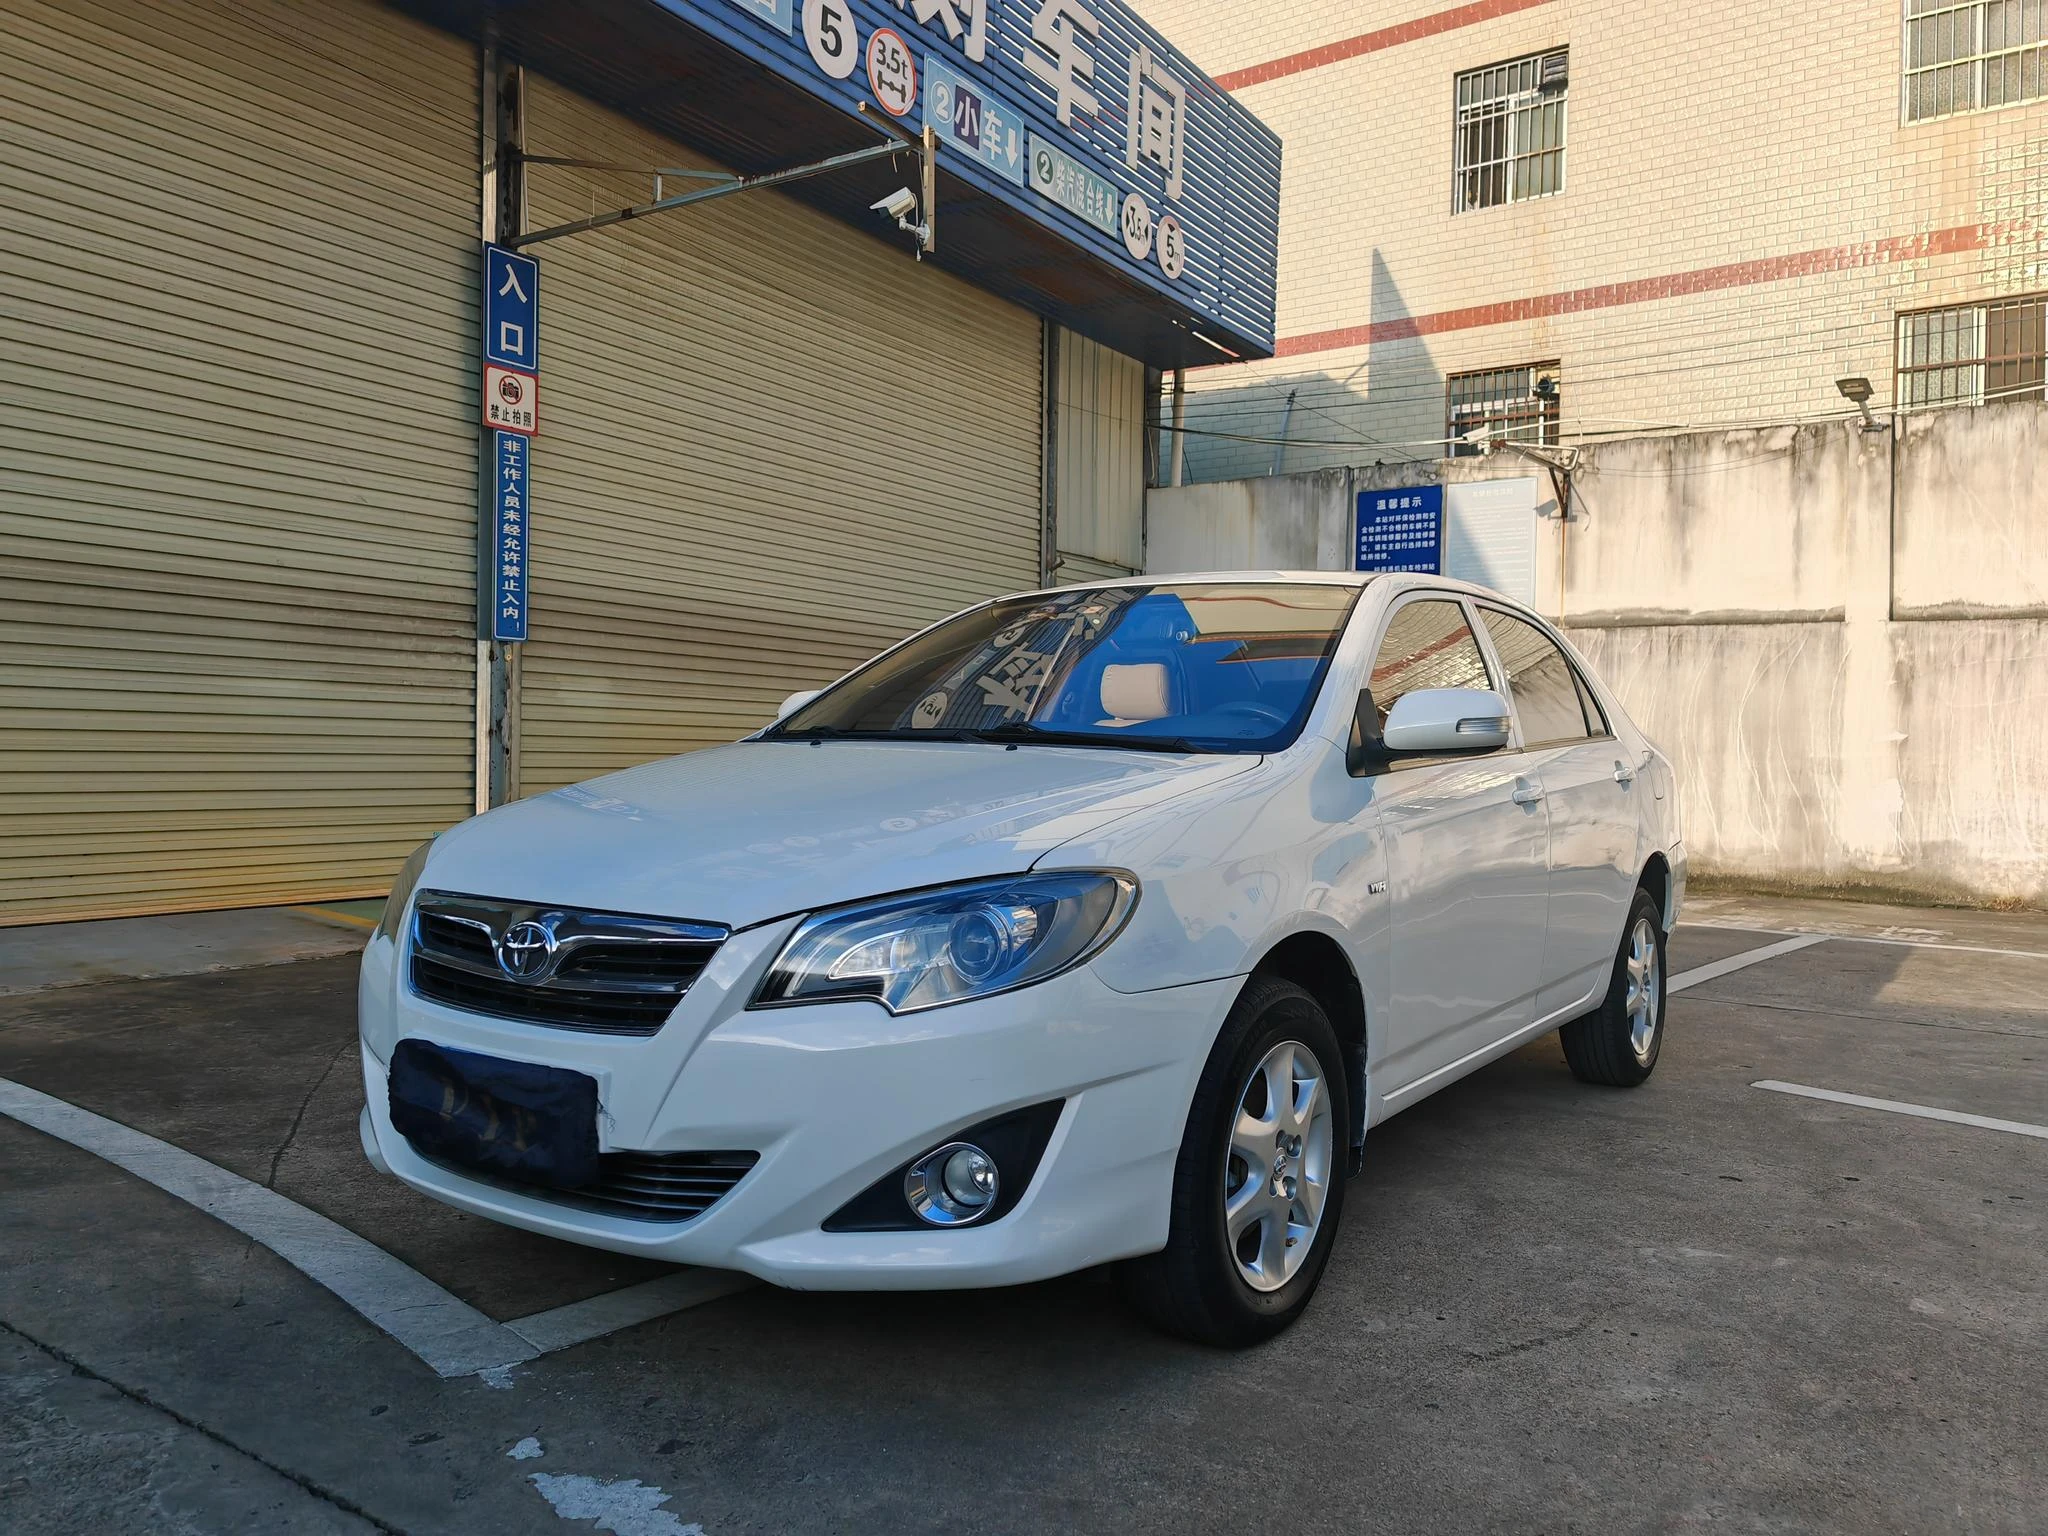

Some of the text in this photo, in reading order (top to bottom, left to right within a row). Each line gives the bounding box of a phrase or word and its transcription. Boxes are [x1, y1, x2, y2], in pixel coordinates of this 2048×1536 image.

[820, 4, 843, 57] 5
[876, 38, 908, 80] 3.5t
[499, 263, 528, 356] 入口
[490, 403, 532, 428] 禁止拍照
[1376, 496, 1422, 510] 温馨提示
